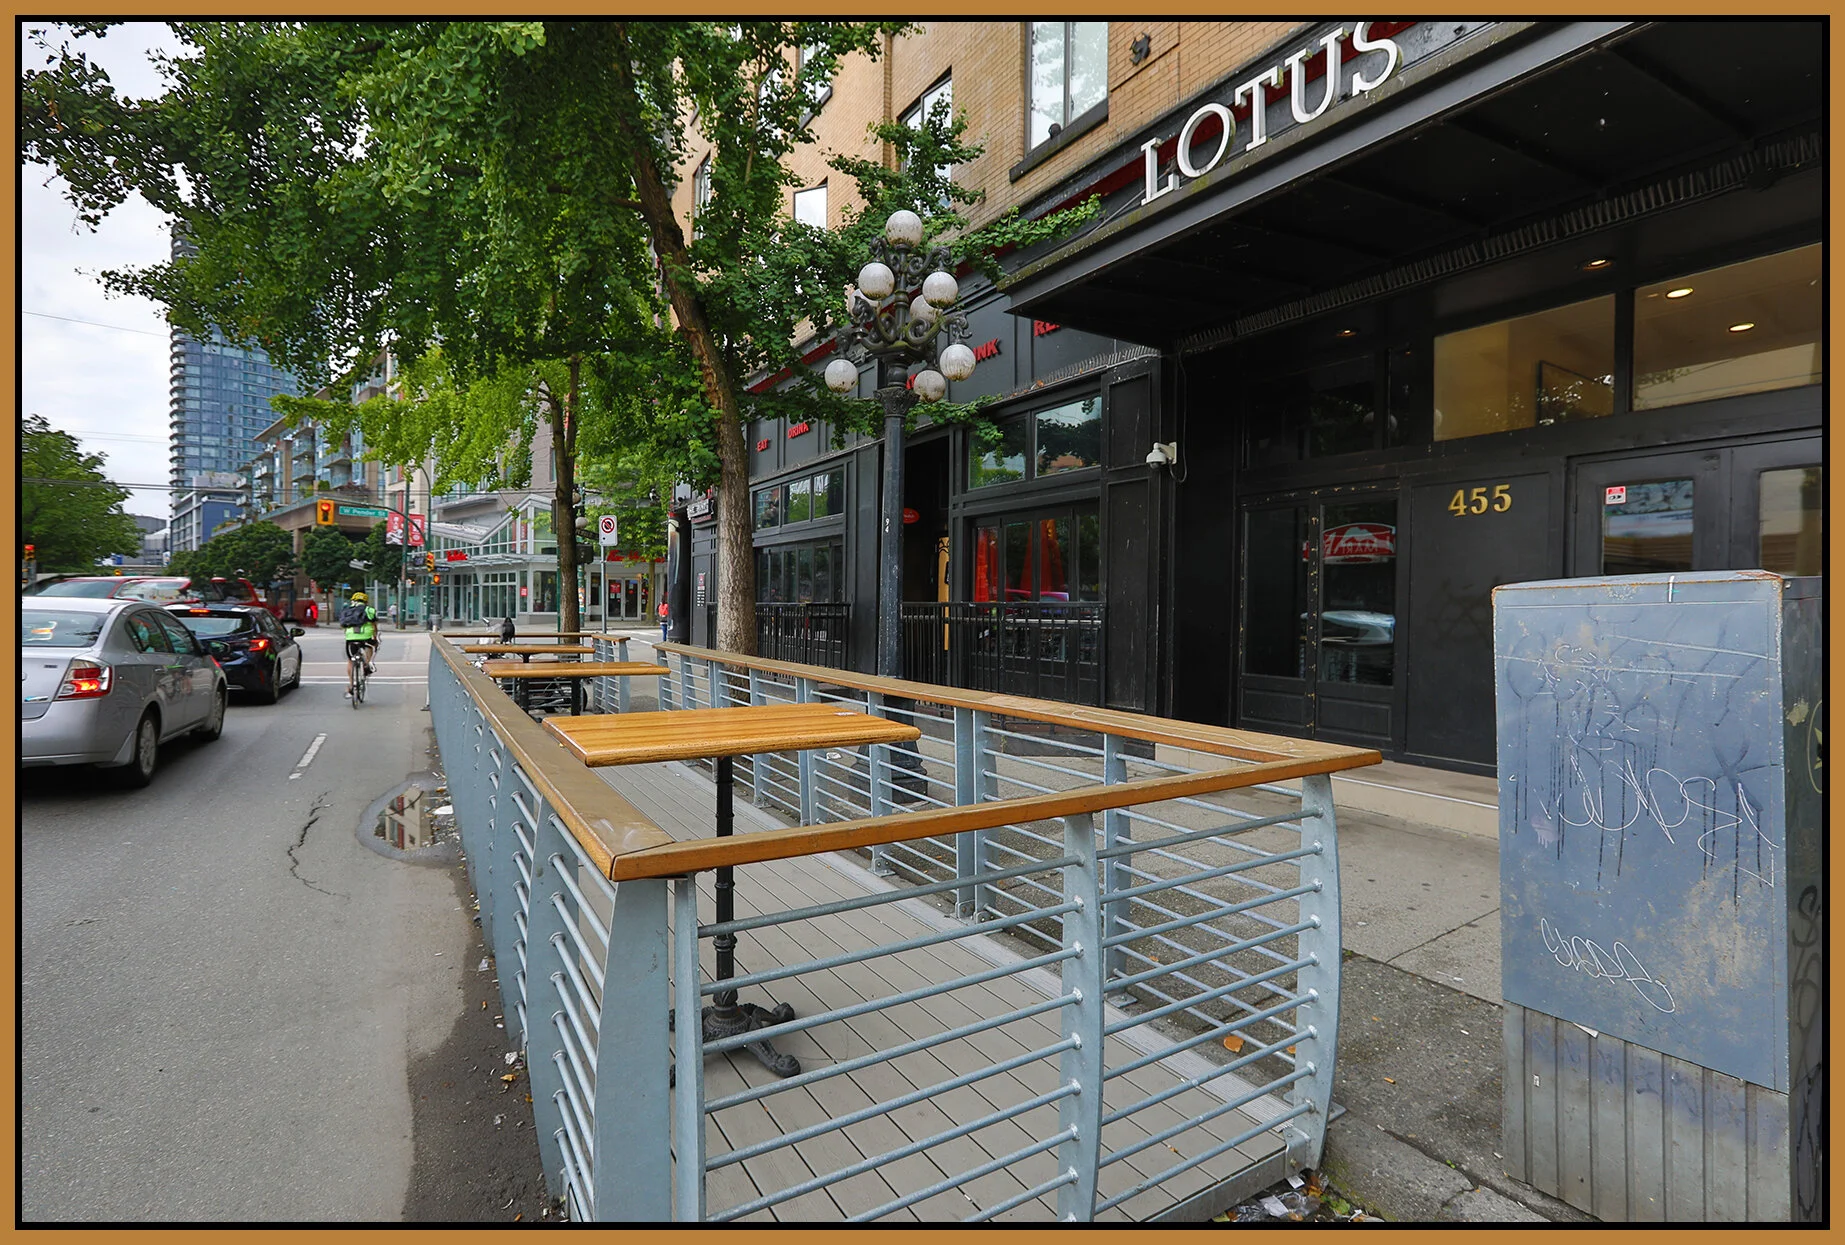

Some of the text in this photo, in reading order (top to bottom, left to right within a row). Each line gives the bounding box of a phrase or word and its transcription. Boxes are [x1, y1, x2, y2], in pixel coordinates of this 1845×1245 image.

[1140, 21, 1400, 206] LOTUS
[757, 438, 769, 452] EAT
[1447, 484, 1512, 516] 455
